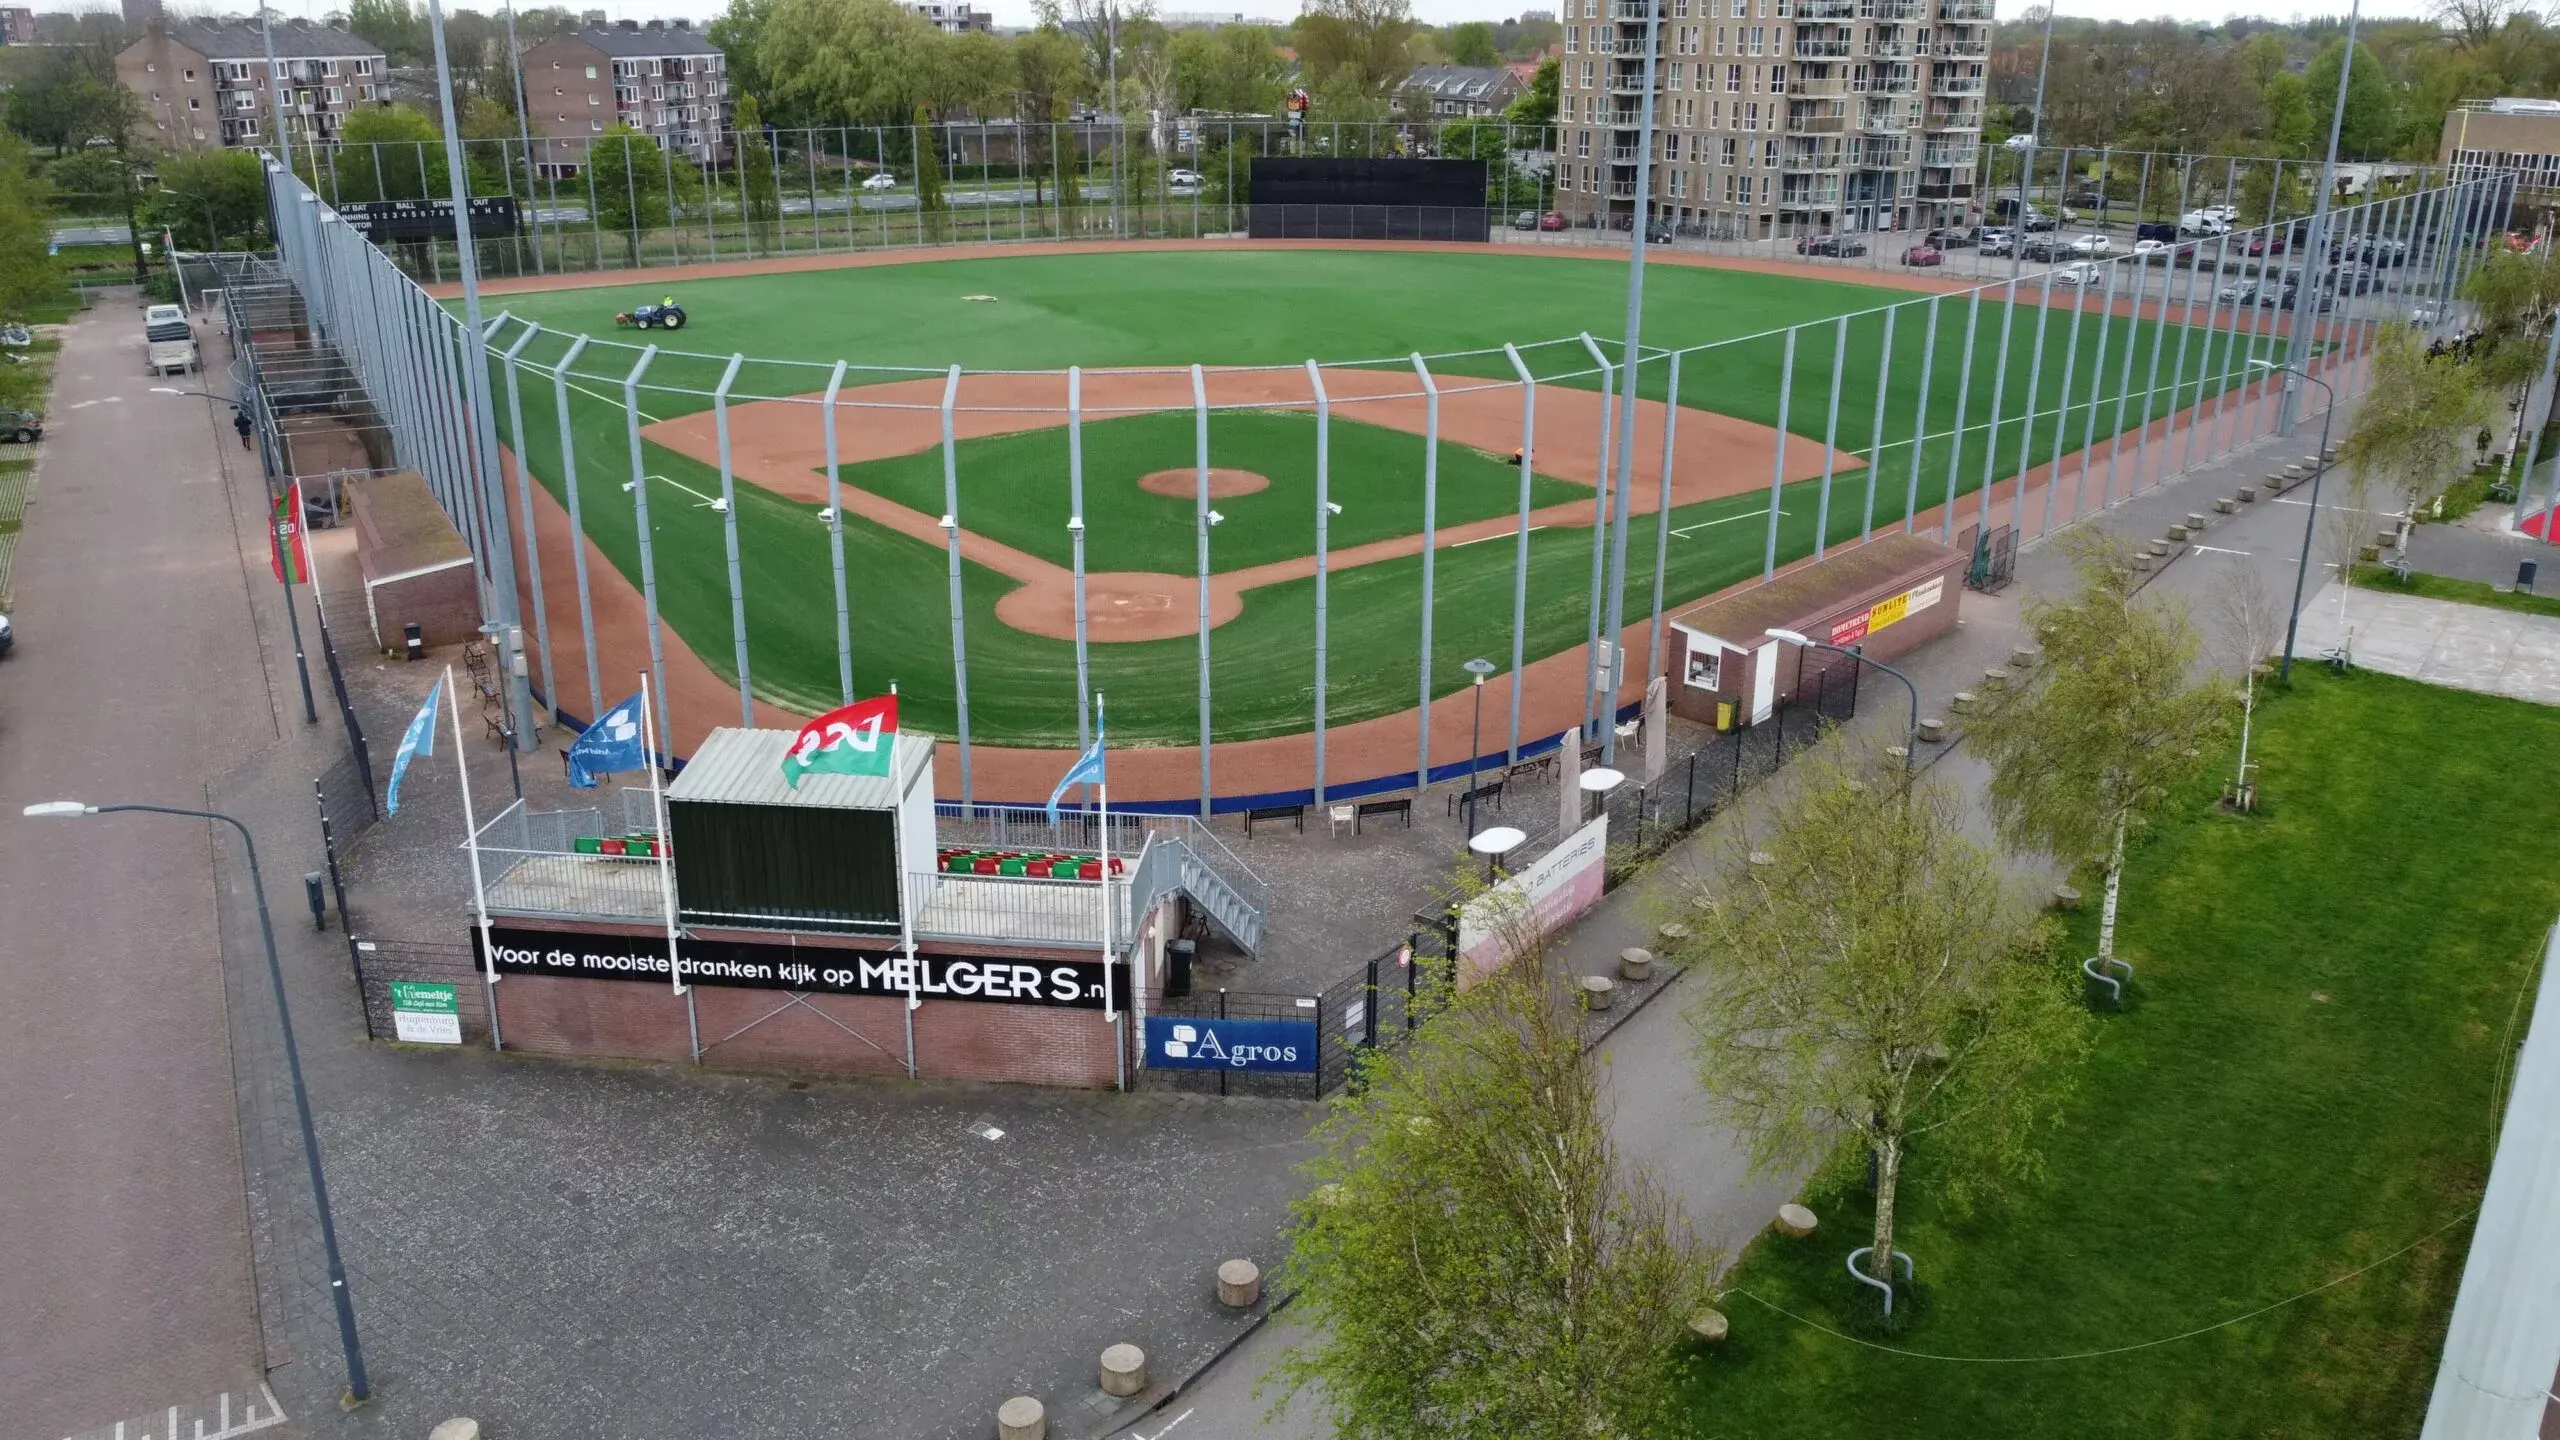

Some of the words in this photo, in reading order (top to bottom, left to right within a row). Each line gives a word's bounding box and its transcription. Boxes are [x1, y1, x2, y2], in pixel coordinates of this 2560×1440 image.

[352, 204, 368, 212] BAT
[396, 202, 416, 210] BALL
[432, 200, 455, 208] STRIK
[1872, 594, 1908, 617] SUNLITE
[1536, 837, 1596, 887] BATTERIES
[490, 945, 540, 964] Voor
[547, 949, 576, 967] de
[583, 952, 670, 973] mooiste
[679, 957, 772, 979] dranken
[779, 962, 817, 985] kijk
[823, 967, 855, 988] op
[859, 956, 1105, 1001] MELGERS.n
[1191, 1028, 1297, 1067] Agros
